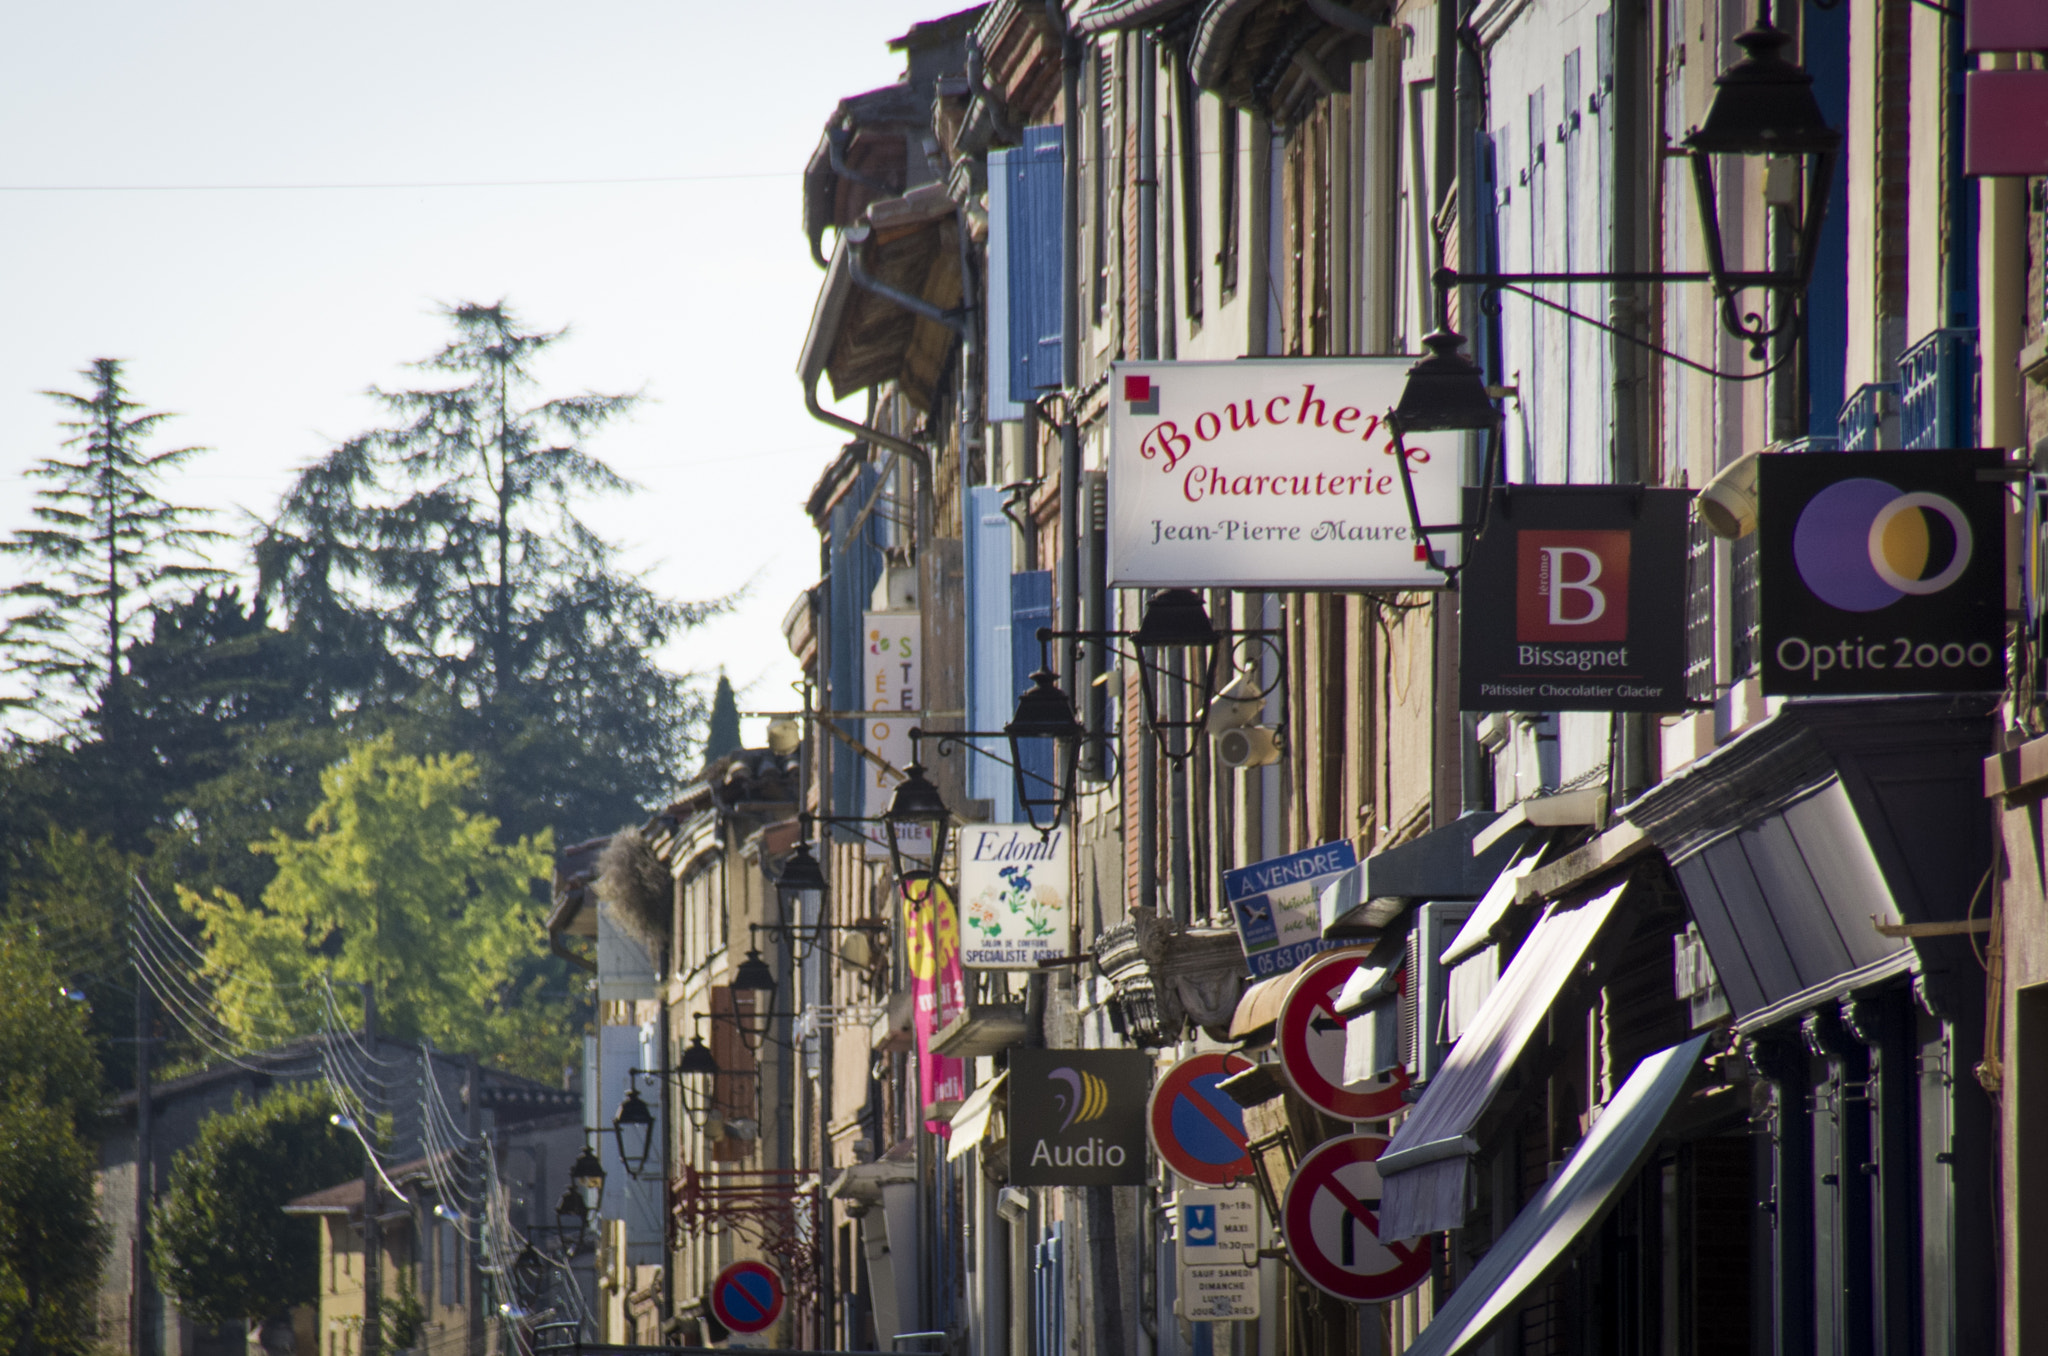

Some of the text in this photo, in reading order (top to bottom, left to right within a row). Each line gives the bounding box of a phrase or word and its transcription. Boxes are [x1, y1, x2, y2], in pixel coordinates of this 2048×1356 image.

[1140, 384, 1431, 474] Bouchere
[1183, 465, 1393, 502] Charcuterie
[1151, 519, 1420, 545] Jean-Pierre Maure
[1540, 547, 1605, 625] B
[1518, 645, 1629, 671] Bissagnet
[1776, 635, 1993, 681] Optic 2000
[1480, 683, 1663, 698] Pâtissier Chocolatier Glacier
[873, 827, 922, 840] LUILE
[972, 831, 1062, 862] Edonil
[1241, 850, 1343, 895] A VENDRE
[966, 949, 1027, 963] SPECIALISTE
[1257, 953, 1275, 974] 05
[1276, 948, 1294, 968] 63
[1030, 1137, 1126, 1167] Audio
[1223, 1224, 1249, 1233] MAXI
[1192, 1269, 1253, 1278] SAUF SAMEDI
[1199, 1282, 1245, 1291] DIMANCHE
